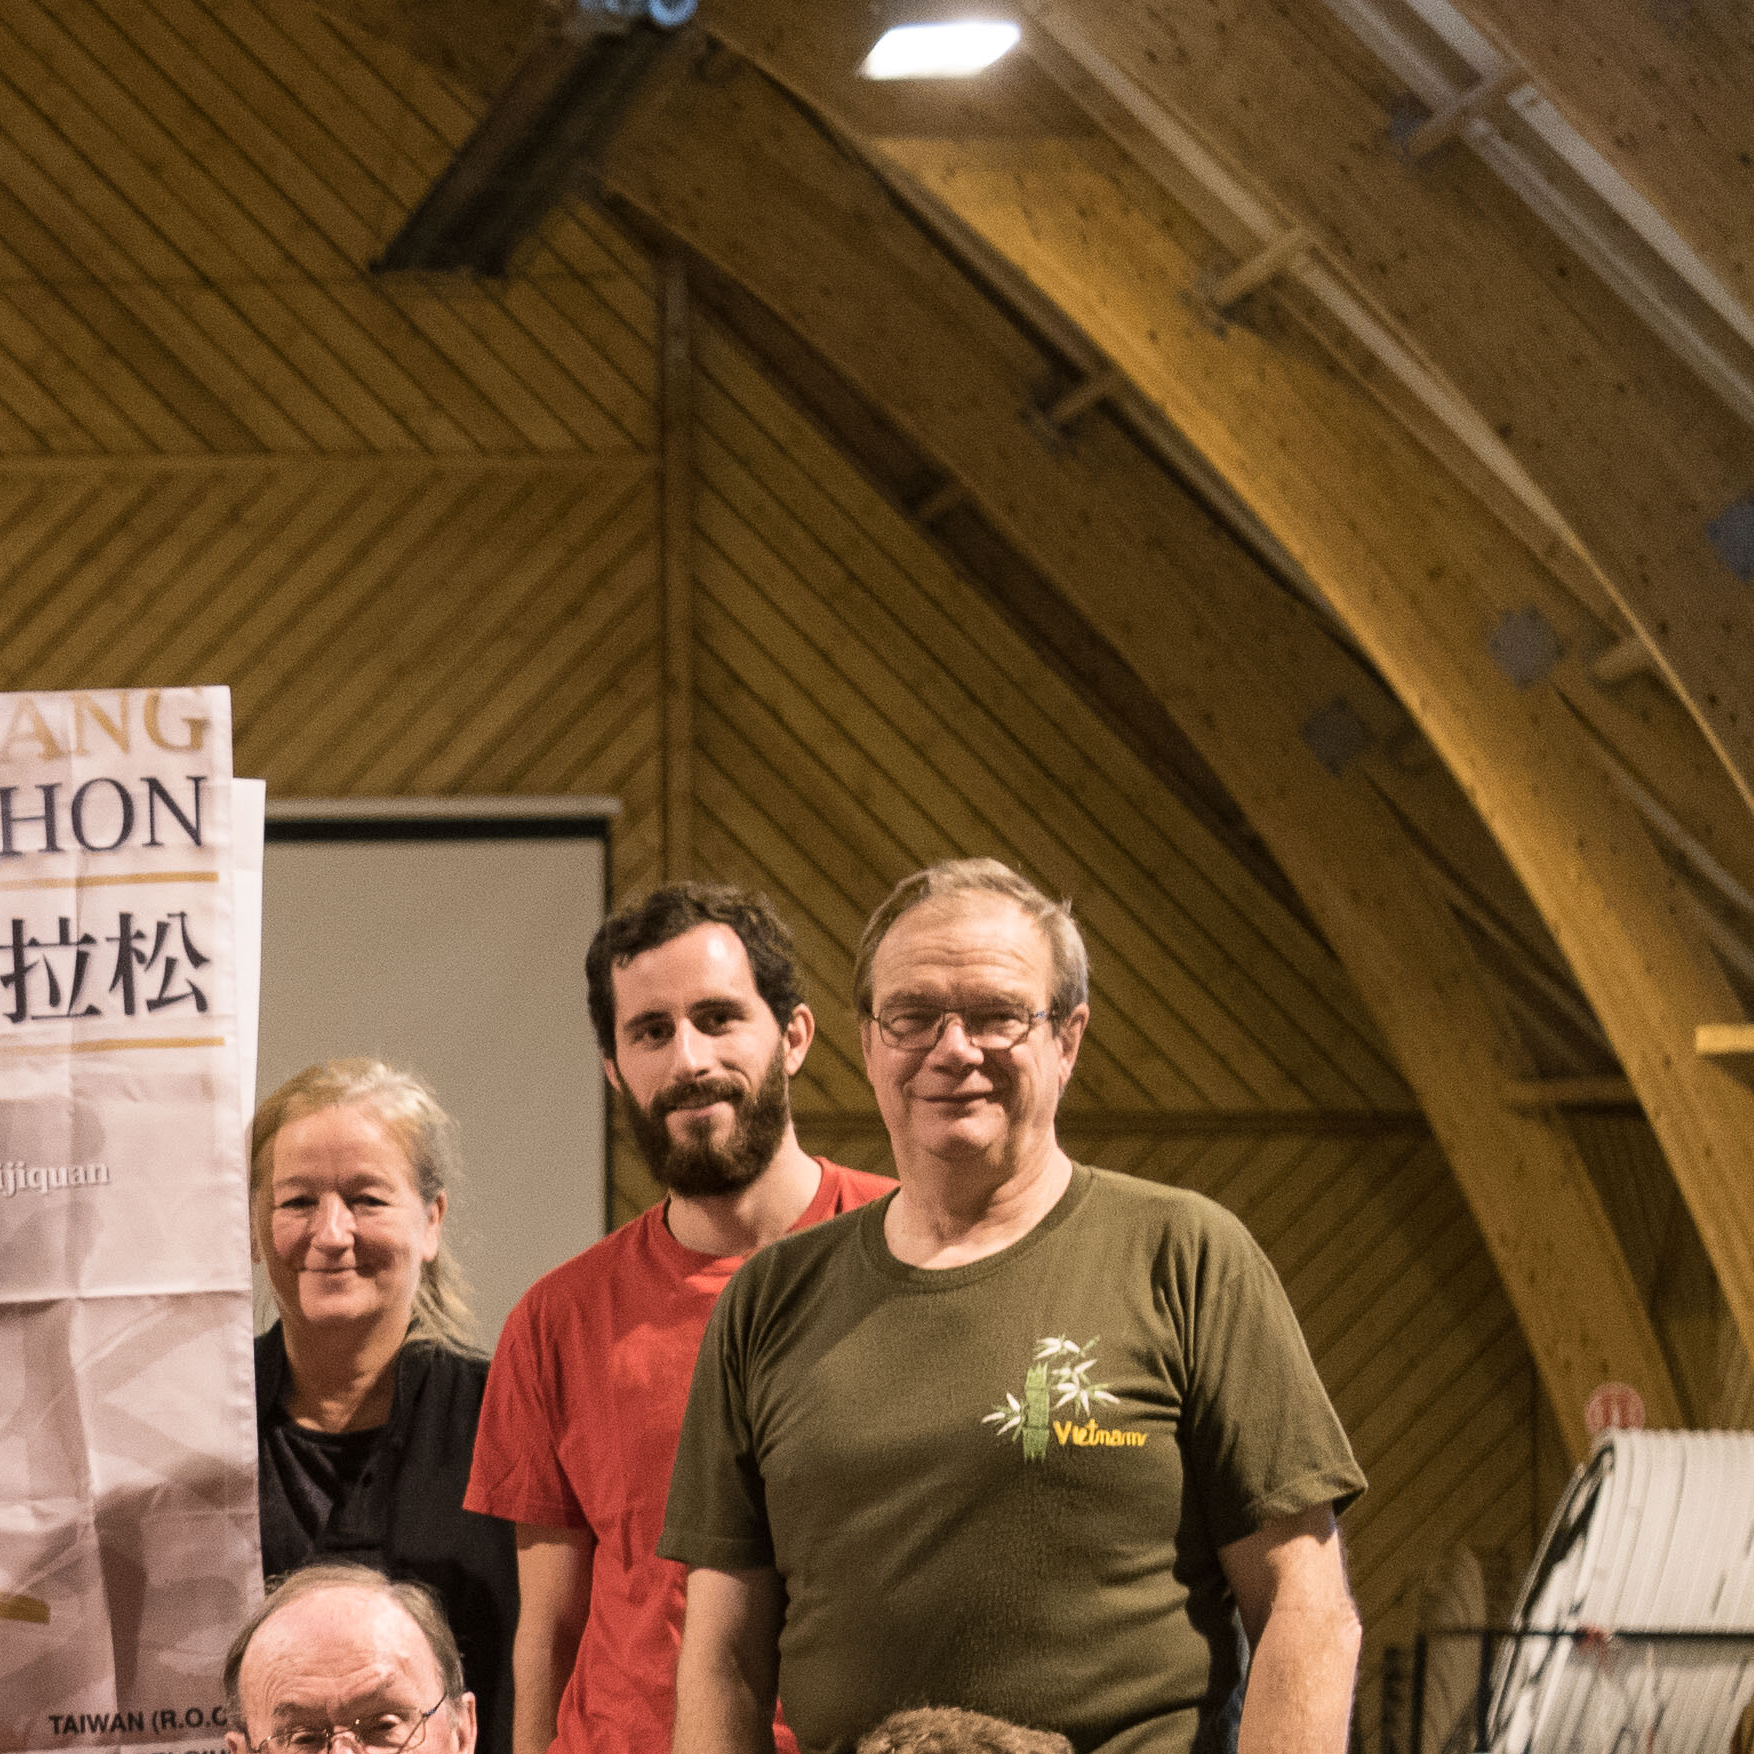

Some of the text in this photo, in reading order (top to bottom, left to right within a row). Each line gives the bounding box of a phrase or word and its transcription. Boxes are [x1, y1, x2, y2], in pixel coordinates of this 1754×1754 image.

[1053, 1418, 1147, 1446] Vietnam
[48, 1706, 227, 1735] TAIWAN (R.O.C
